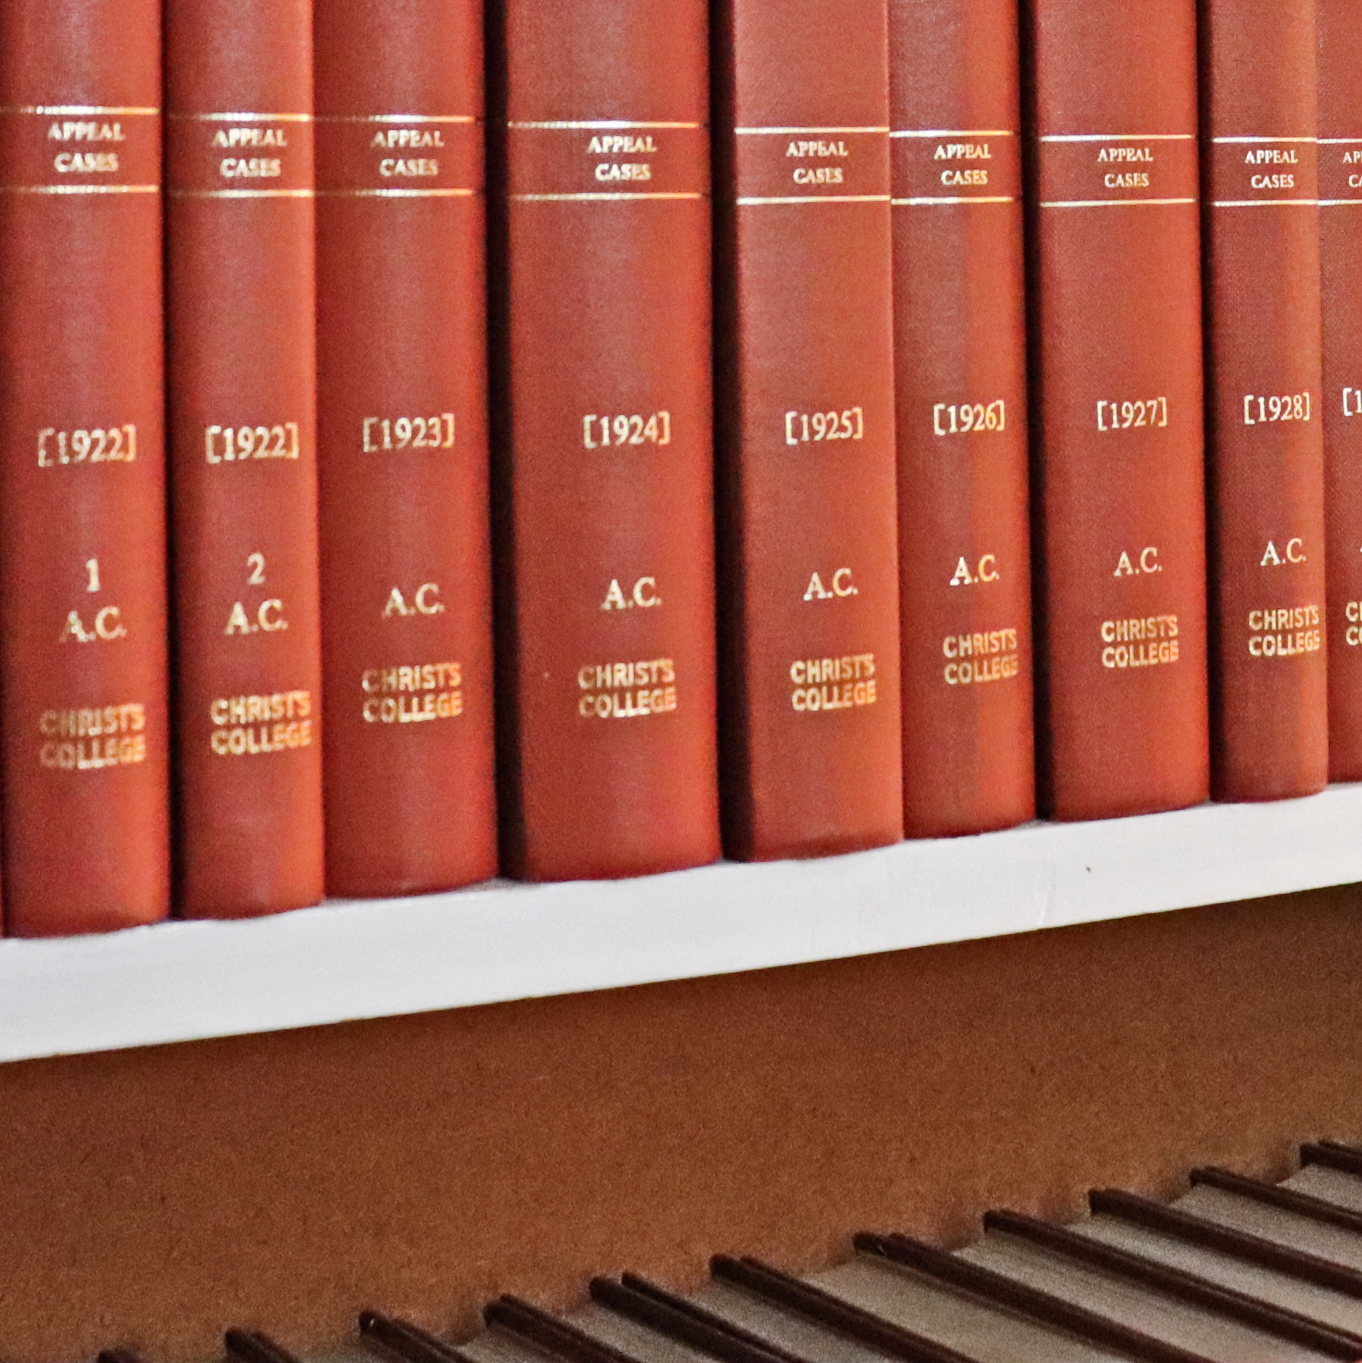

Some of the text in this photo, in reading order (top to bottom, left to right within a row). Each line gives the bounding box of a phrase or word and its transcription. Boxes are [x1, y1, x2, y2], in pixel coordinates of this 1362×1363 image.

[211, 129, 288, 149] APPEAL
[786, 140, 849, 159] APPEAL
[1097, 147, 1154, 163] APPEAL
[219, 158, 282, 178] CASES
[793, 167, 843, 186] CASES
[1104, 173, 1150, 188] CASES
[933, 400, 1006, 436] [1926]
[1097, 396, 1168, 432] [1927]
[1243, 392, 1311, 425] [1928]
[205, 421, 299, 464] [1922]
[362, 412, 456, 453] [1923]
[583, 410, 671, 449] [1924]
[785, 407, 863, 445] [1925]
[37, 424, 137, 468] [1922]
[247, 553, 266, 585] 2
[1114, 547, 1163, 577] A.C.
[1260, 538, 1306, 567] A.C.
[86, 558, 100, 592] 1
[803, 568, 859, 602] A.C.
[949, 554, 1000, 587] A.C.
[382, 583, 446, 617] A.C.
[601, 576, 662, 611] A.C.
[59, 606, 128, 643] A.C.
[224, 599, 289, 636] A.C.
[1102, 640, 1180, 669] COLLEGE
[1249, 629, 1320, 657] COLLEGE
[944, 653, 1019, 685] COLLEGE
[362, 691, 464, 723] COLLEGE
[579, 687, 677, 719] COLLEGE
[791, 679, 877, 712] COLLEGE
[39, 734, 146, 770] COLLEGE
[211, 721, 312, 755] COLLEGE
